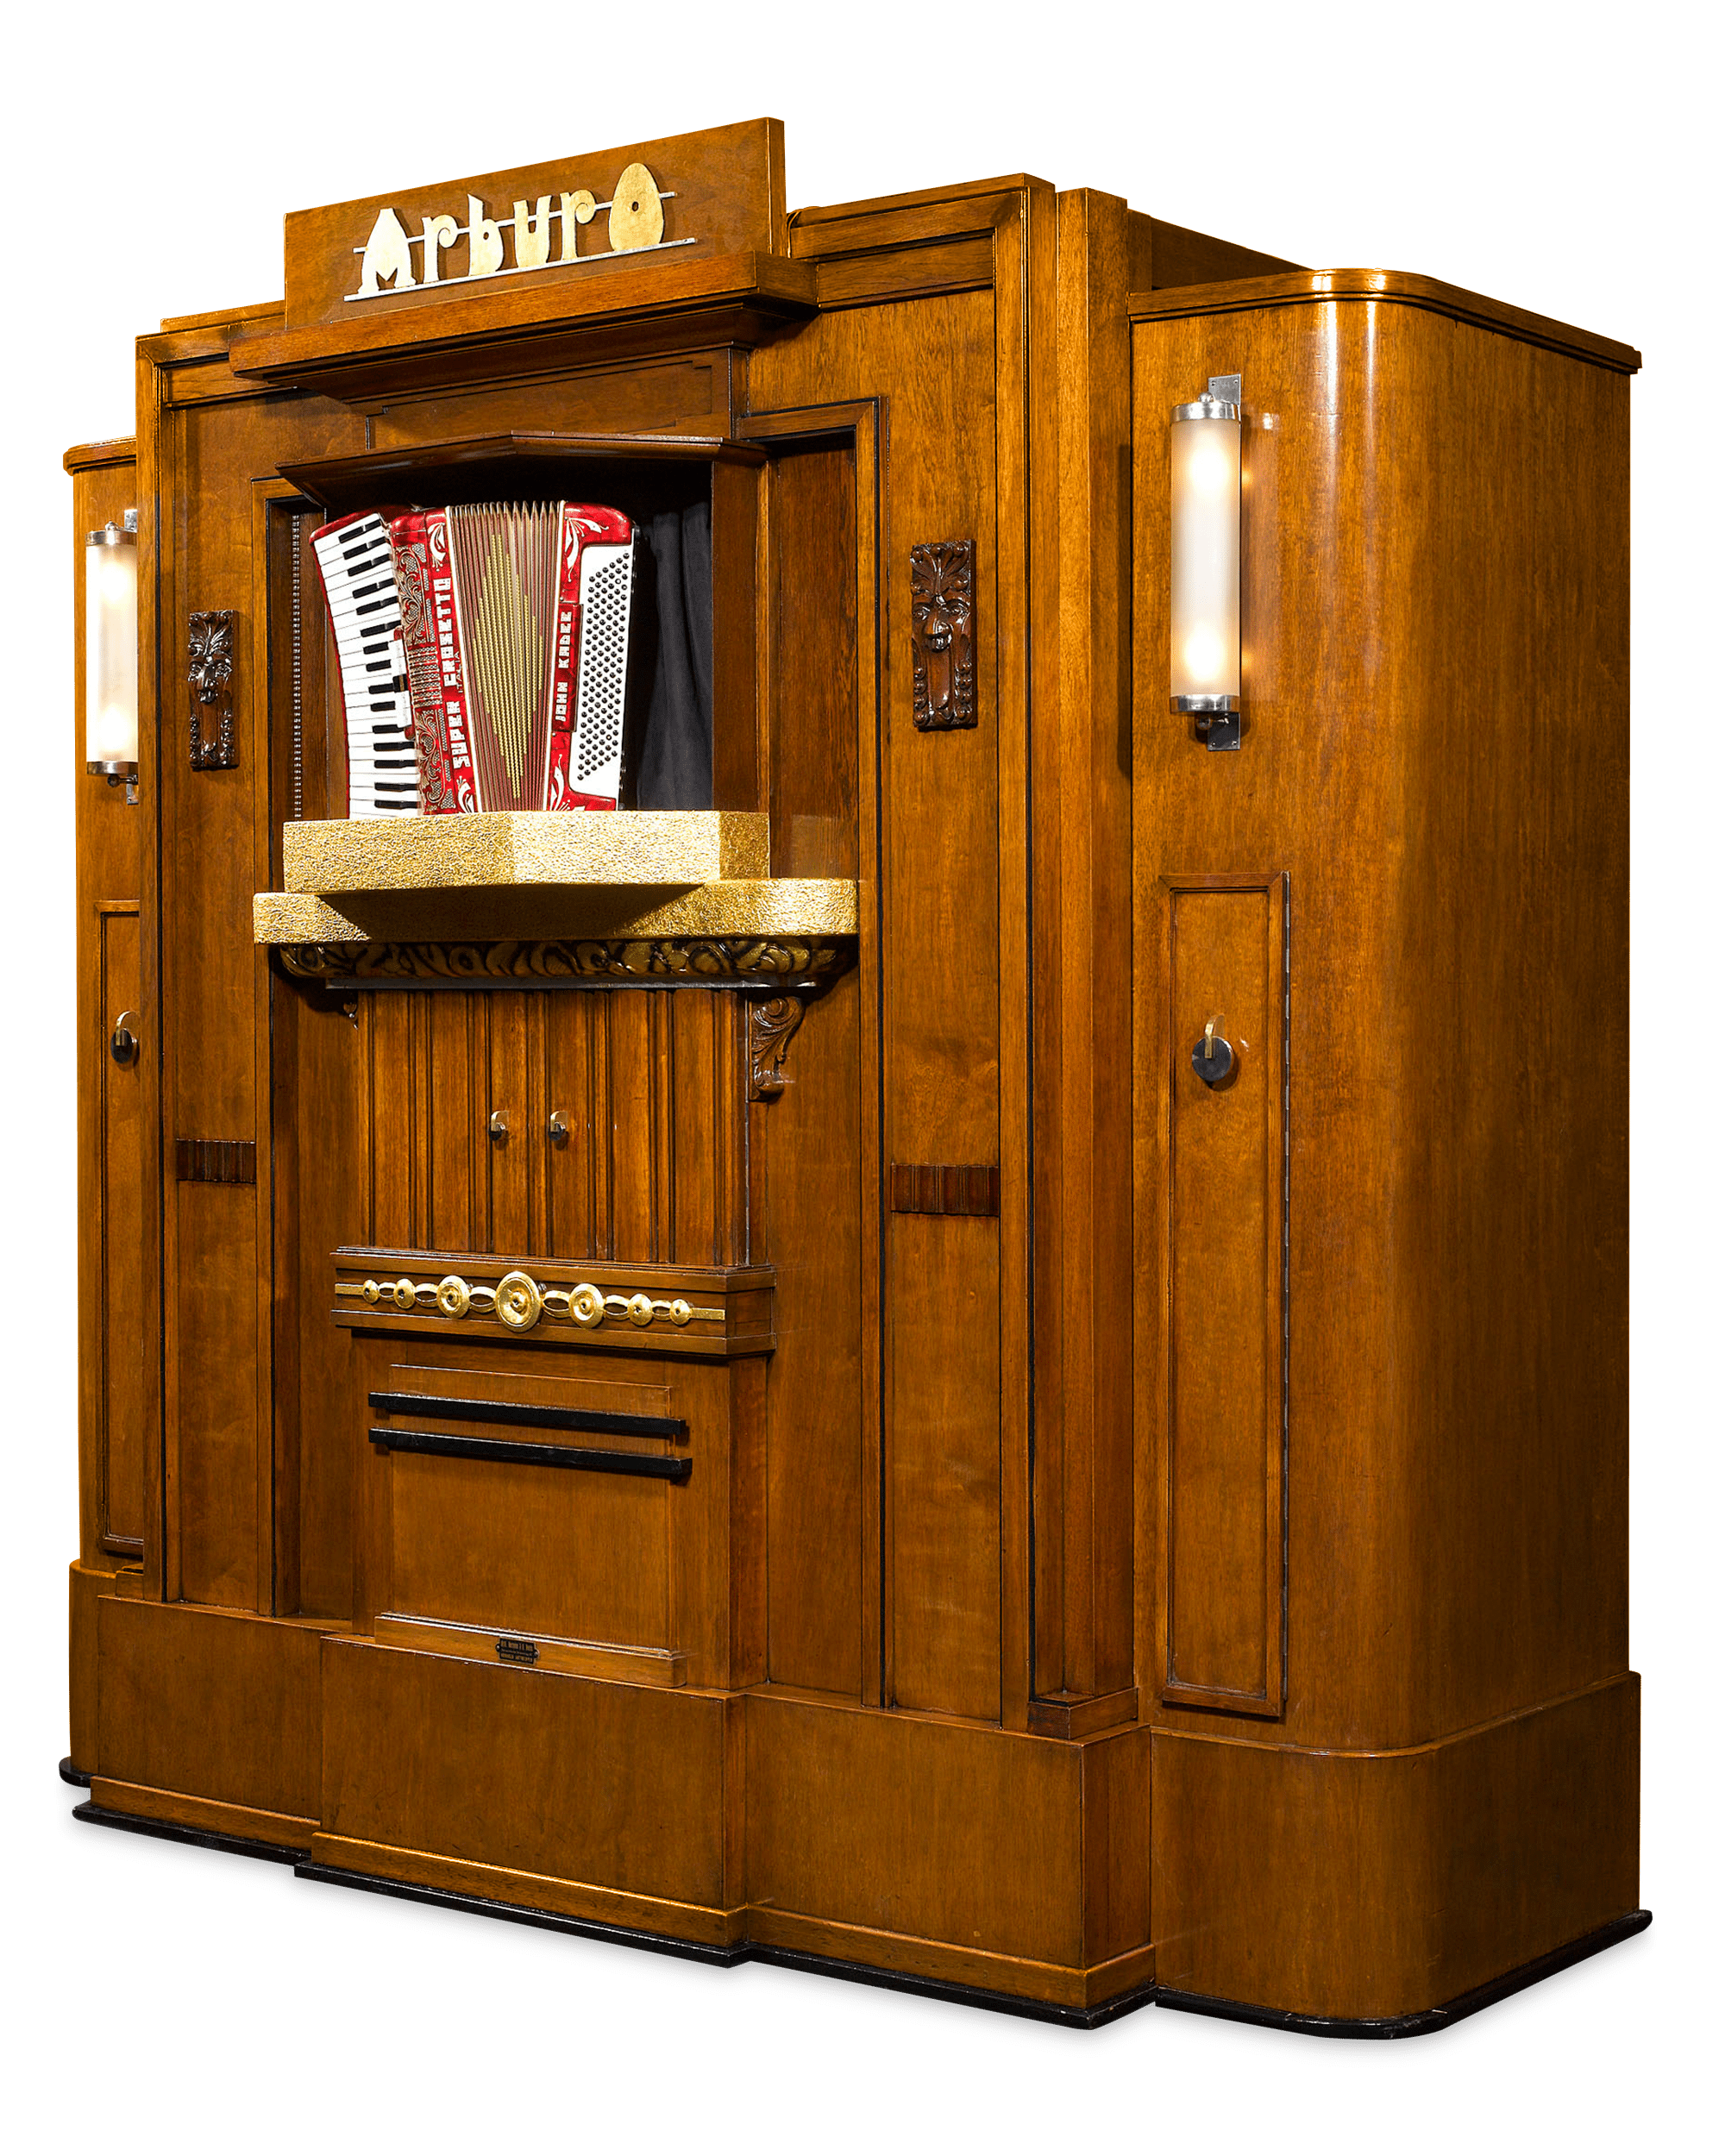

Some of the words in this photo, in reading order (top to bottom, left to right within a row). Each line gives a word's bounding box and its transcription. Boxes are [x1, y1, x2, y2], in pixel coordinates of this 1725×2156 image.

[433, 577, 457, 687] CROSETTO
[558, 611, 573, 668] KADEE
[454, 651, 463, 693] ITALIA
[555, 681, 568, 722] JOHN
[446, 700, 472, 769] SUPER
